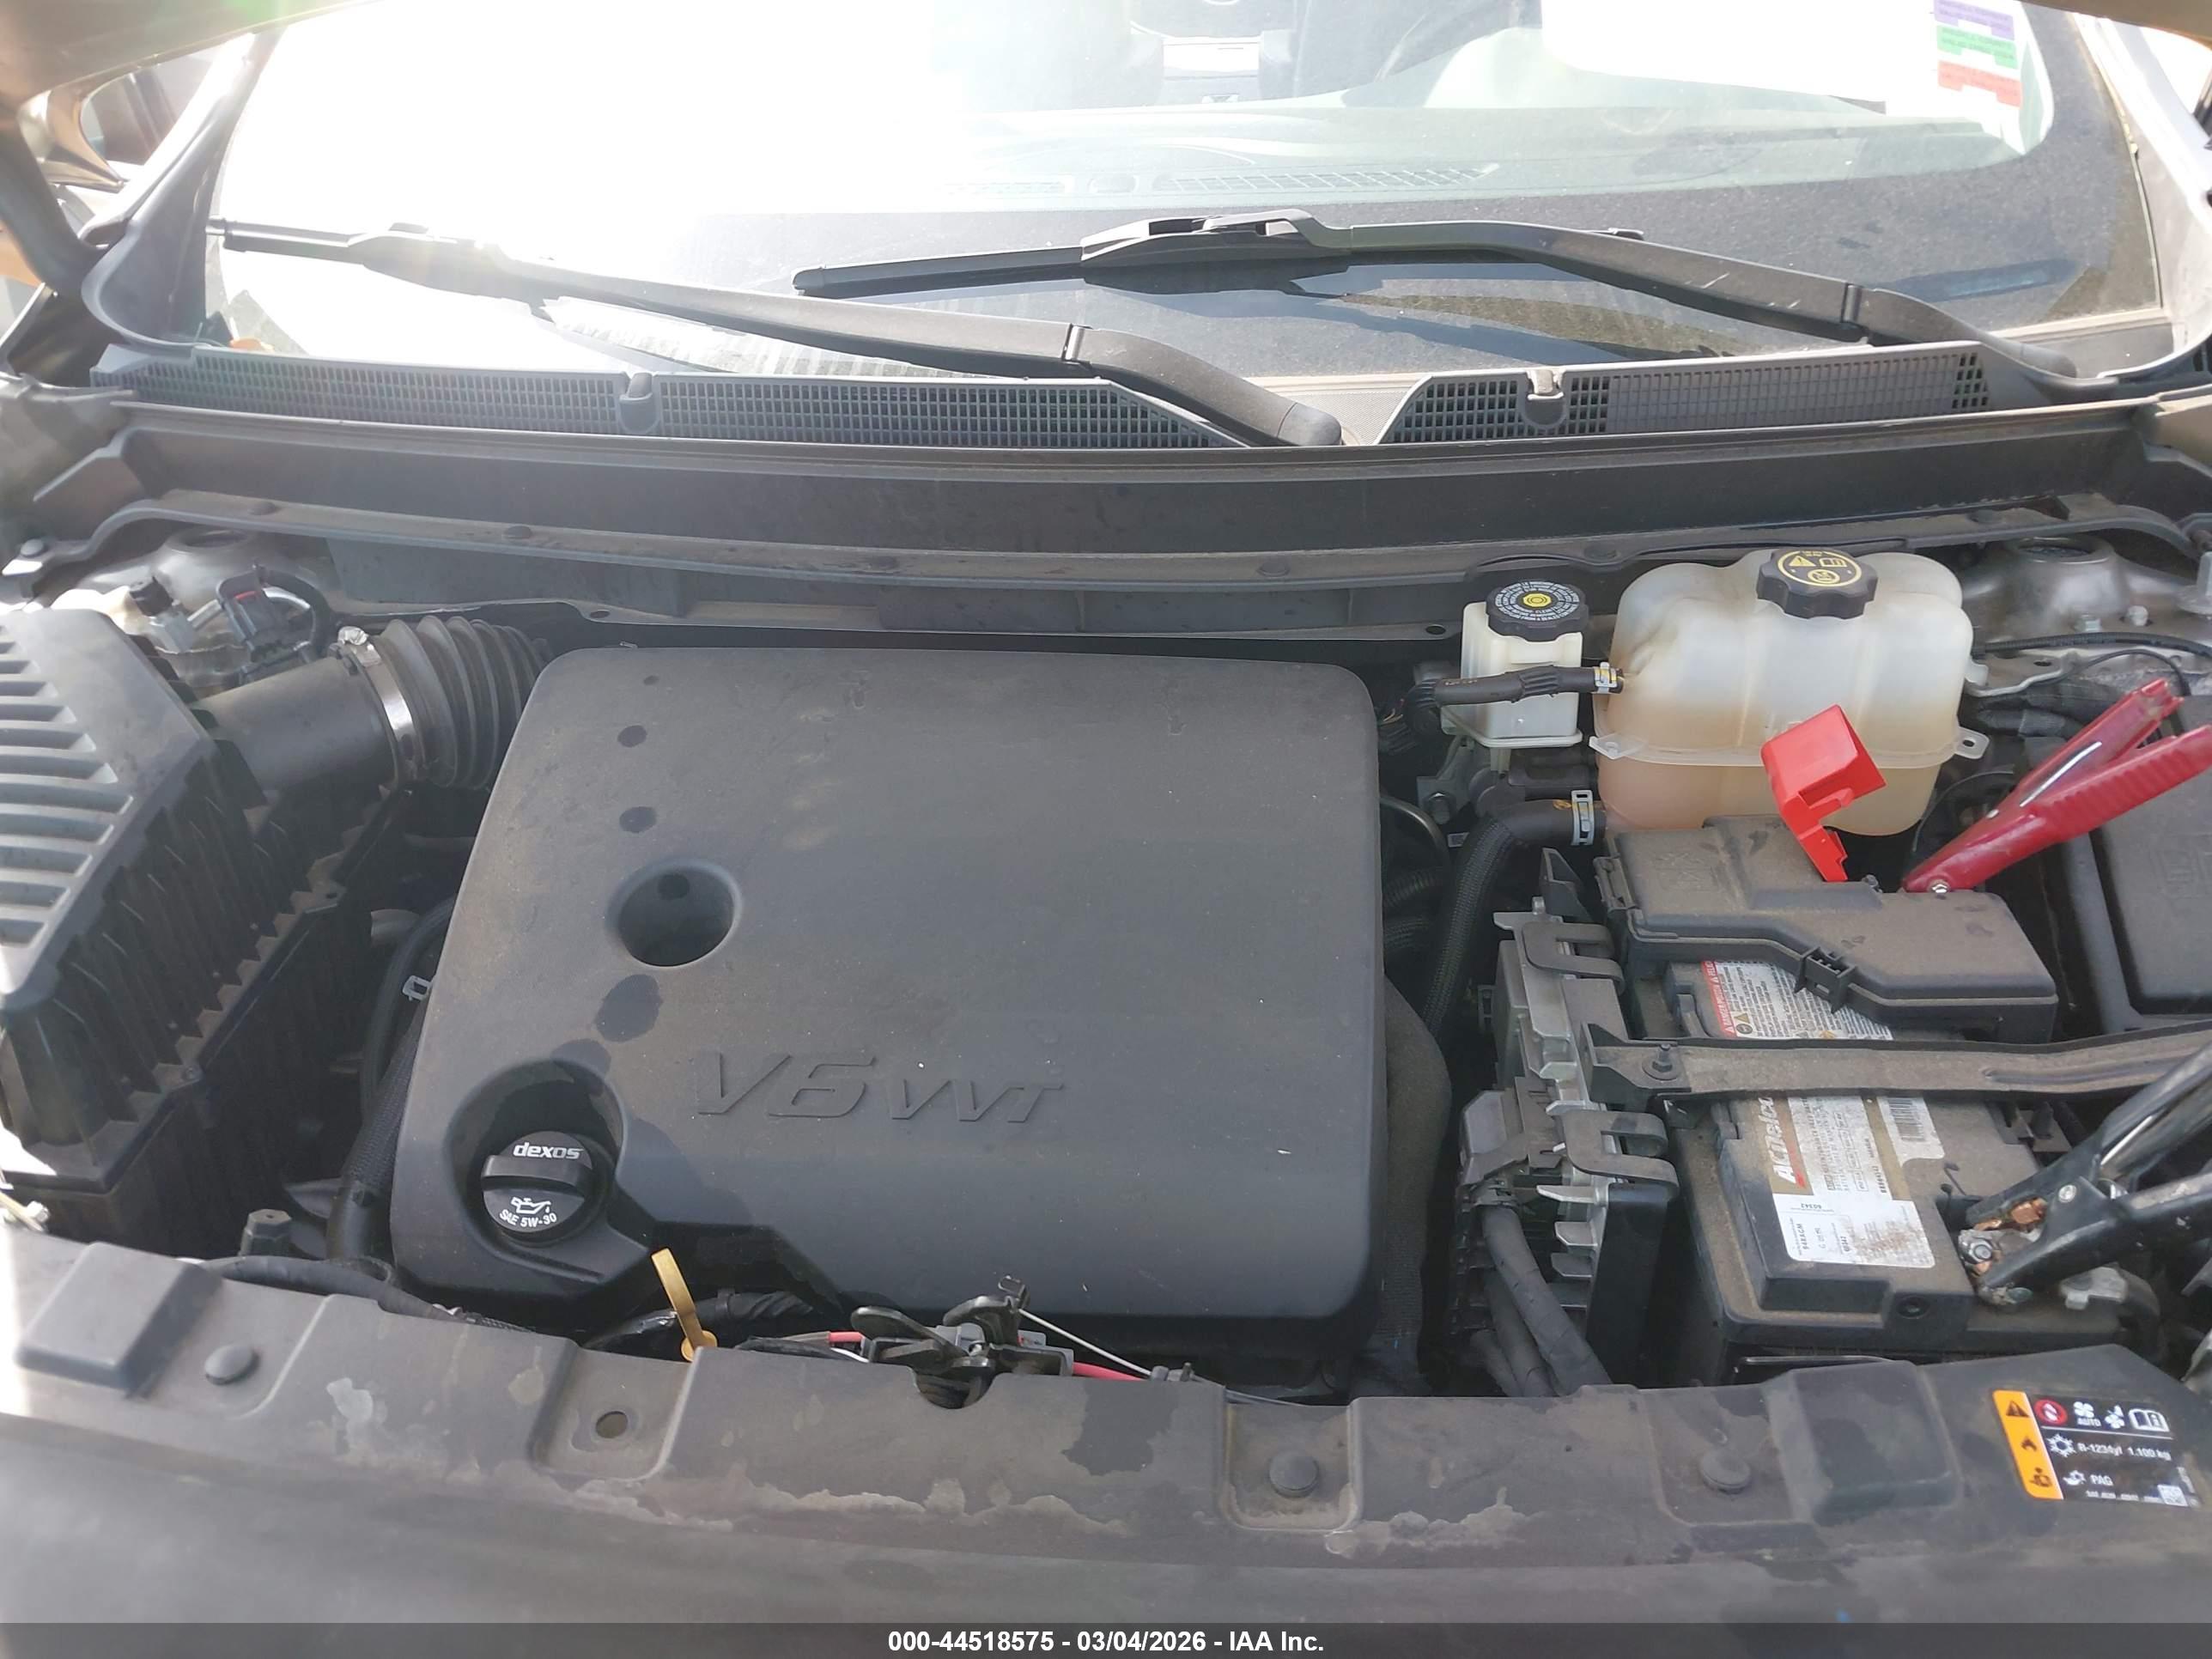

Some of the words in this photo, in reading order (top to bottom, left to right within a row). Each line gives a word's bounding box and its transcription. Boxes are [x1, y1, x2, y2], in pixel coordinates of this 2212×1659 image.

[694, 1051, 877, 1119] V6
[889, 1076, 1065, 1124] VVT
[513, 1141, 585, 1159] dexos
[499, 1208, 520, 1226] SAE
[520, 1212, 558, 1228] 5W-30
[2076, 1418, 2102, 1427] AUTO
[2076, 1442, 2124, 1456] R-1234yf
[2127, 1446, 2156, 1458] 1.100
[2156, 1449, 2172, 1462] kg
[2089, 1474, 2114, 1487] PAG
